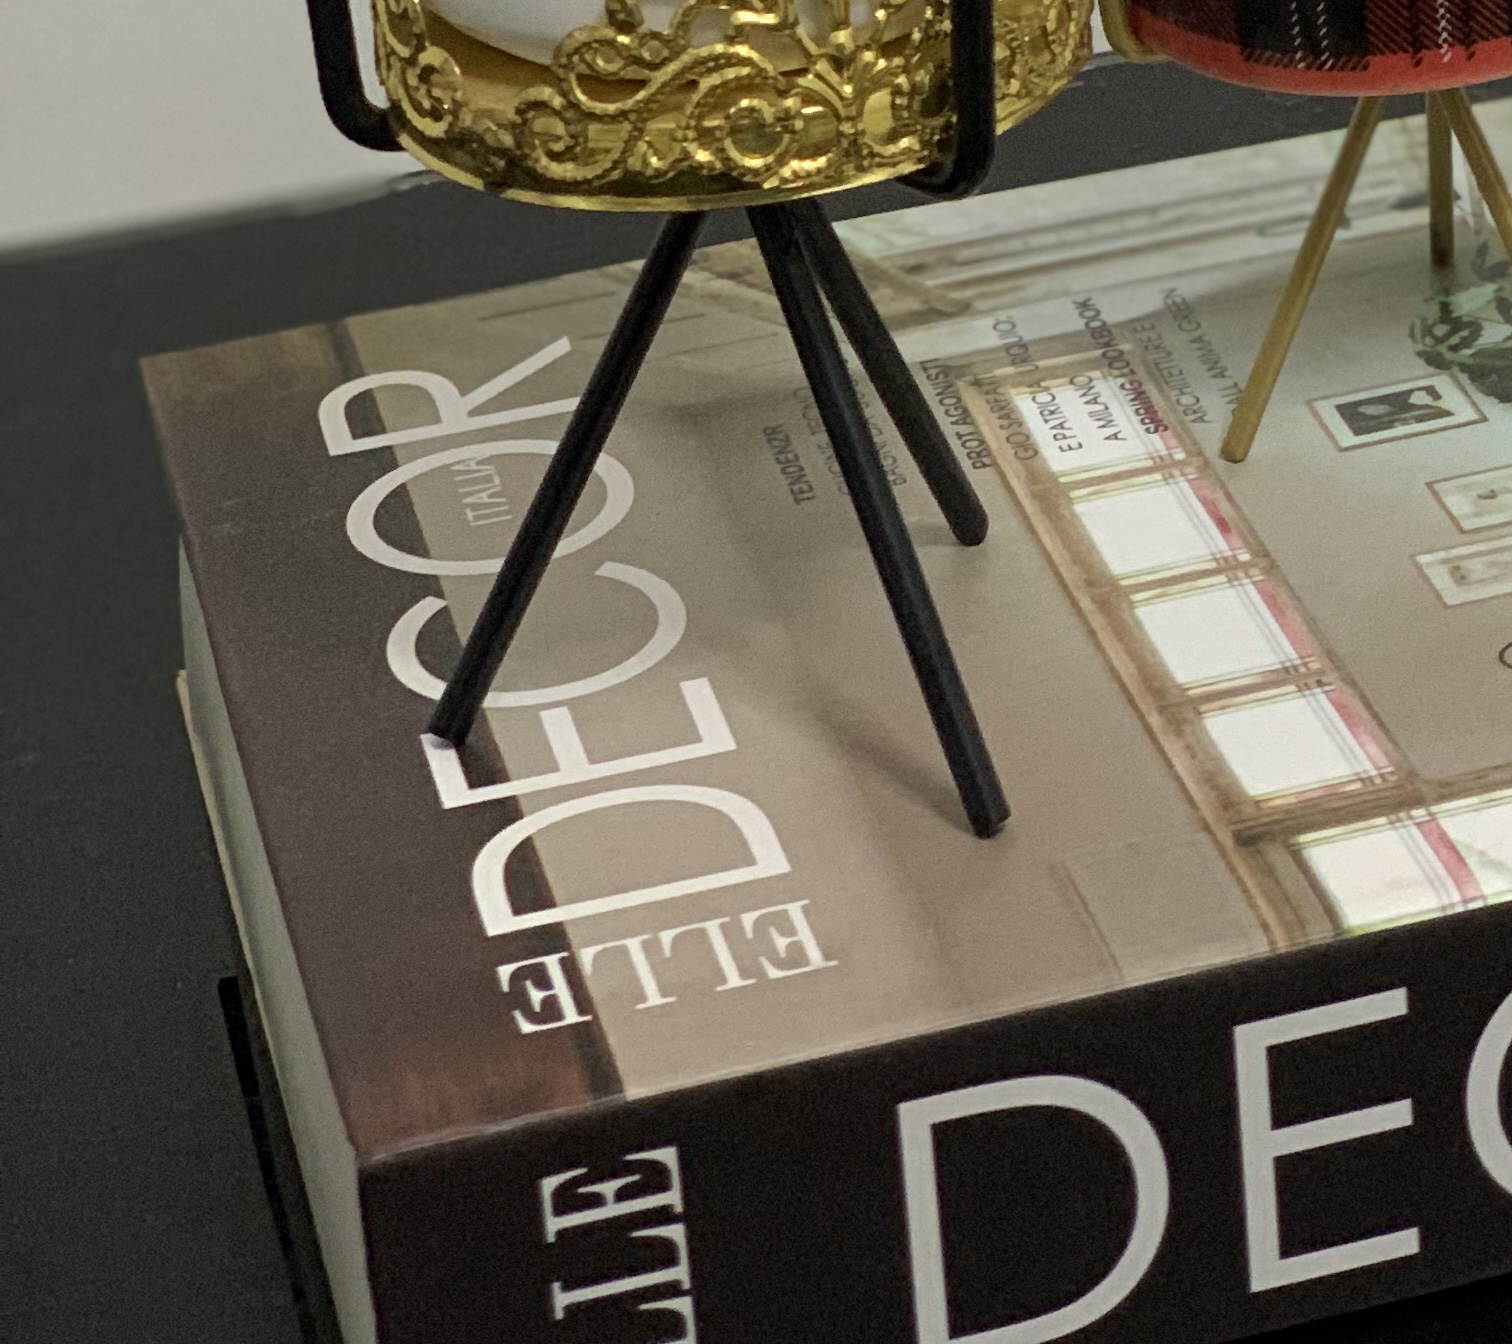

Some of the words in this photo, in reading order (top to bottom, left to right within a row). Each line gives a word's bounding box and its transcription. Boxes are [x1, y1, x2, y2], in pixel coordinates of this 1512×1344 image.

[1069, 296, 1138, 379] LOOKBOOK
[1023, 378, 1079, 442] PATRICIA
[1065, 372, 1120, 430] MILANO
[1099, 429, 1128, 444] A
[1116, 378, 1171, 435] SPRING
[449, 453, 514, 527] ITALIA
[317, 335, 792, 937] DECOR
[495, 899, 839, 1035] ELLE
[539, 1145, 698, 1344] LE
